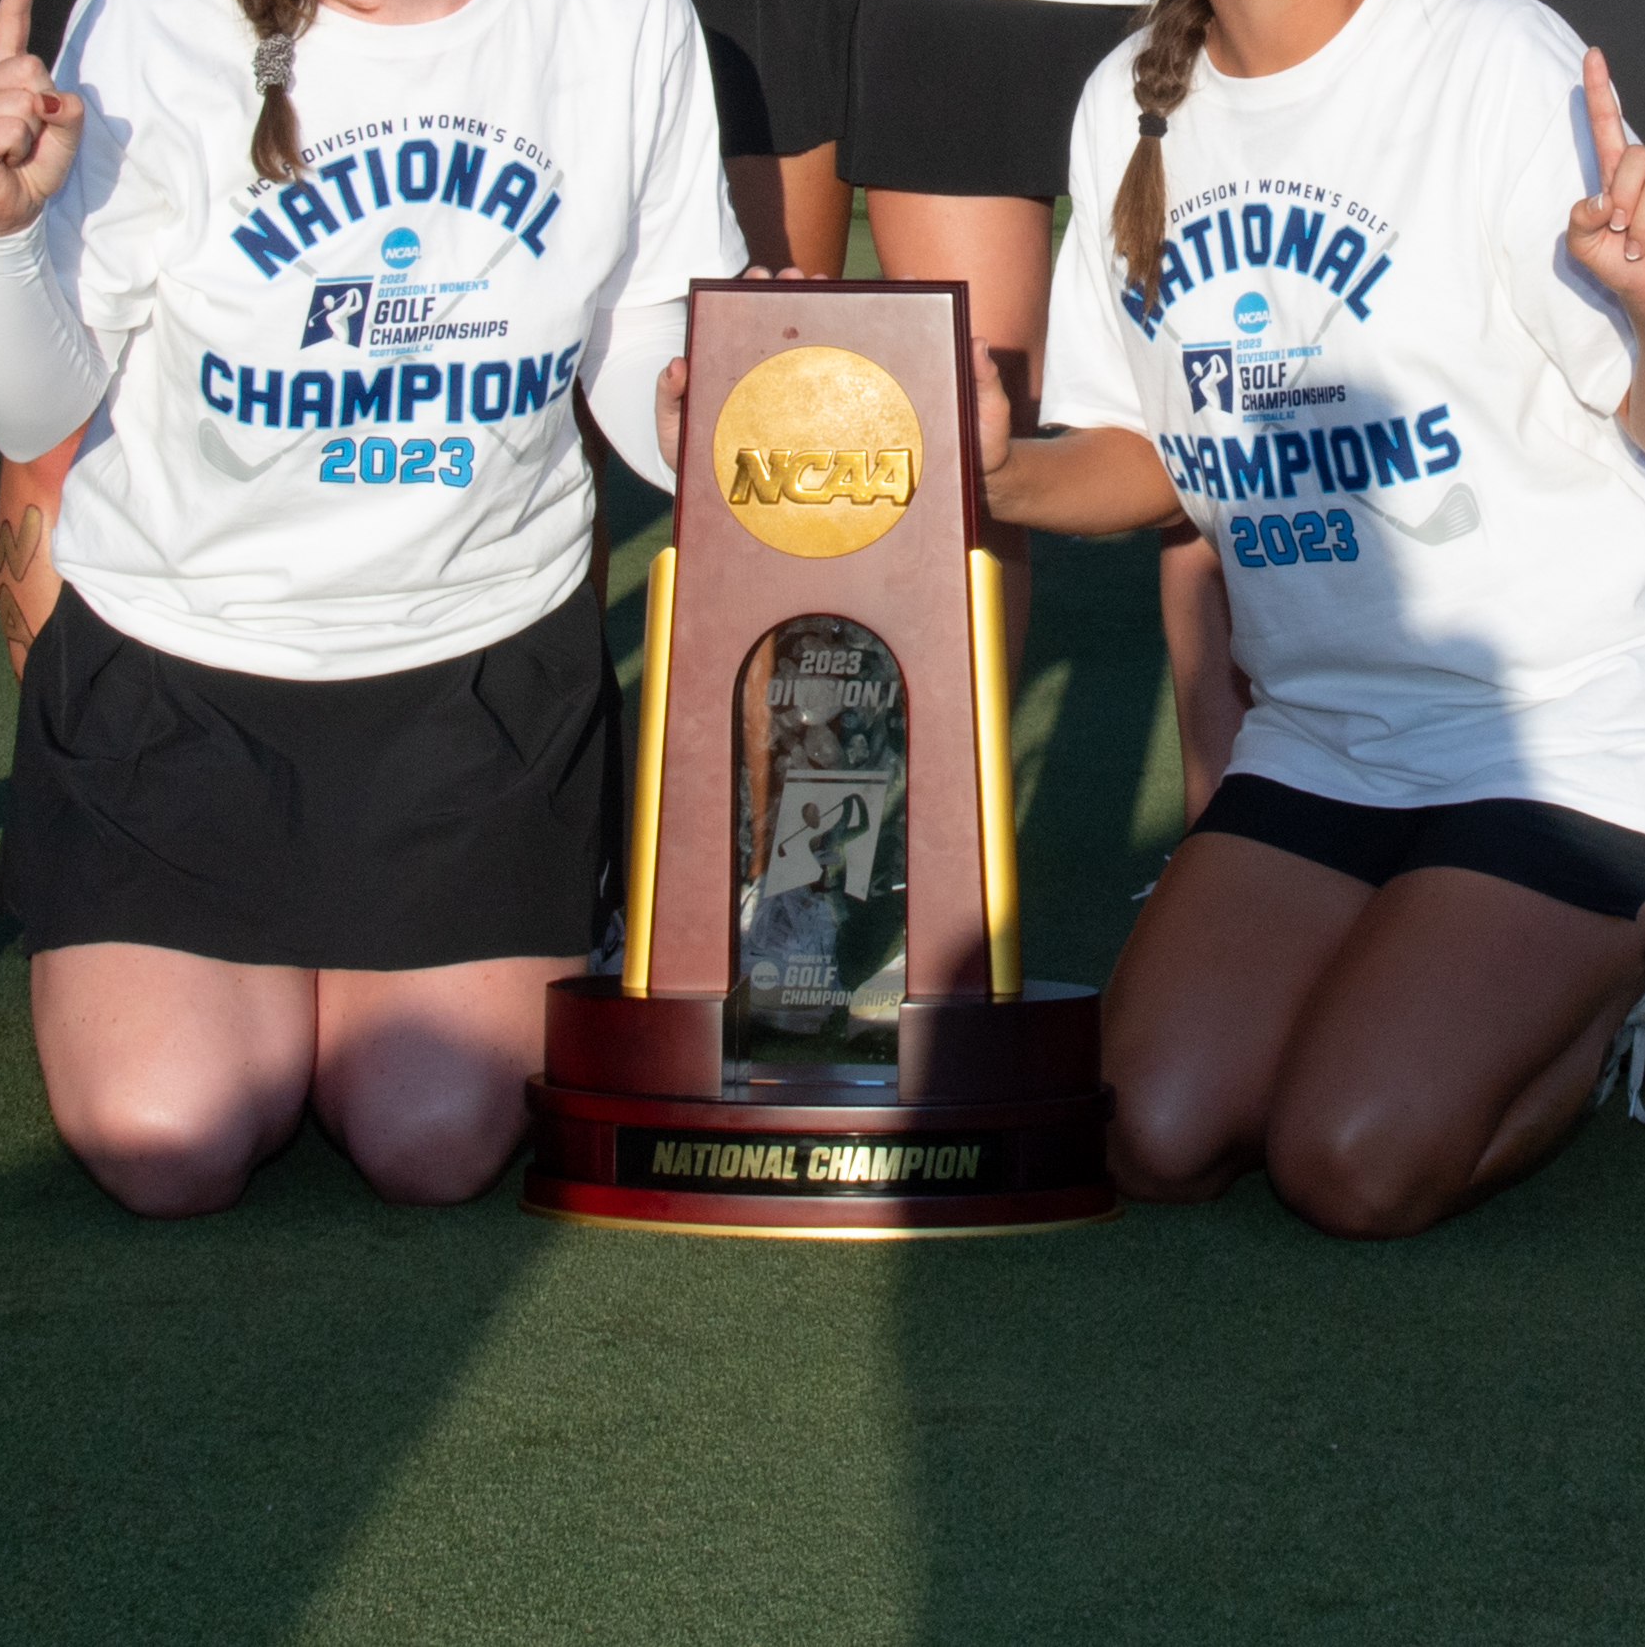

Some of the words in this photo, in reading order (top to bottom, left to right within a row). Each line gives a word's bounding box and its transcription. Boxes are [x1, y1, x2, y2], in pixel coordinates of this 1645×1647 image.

[246, 161, 292, 198] NCA
[302, 120, 394, 164] DIVISION
[419, 114, 507, 144] WOMEN'S
[514, 137, 553, 172] GOLF
[230, 138, 562, 281] NATIONAL
[1170, 182, 1237, 223] DIVISION
[1259, 179, 1343, 208] WOMEN'S
[1346, 201, 1389, 235] GOLF
[384, 246, 419, 260] NCAA
[377, 285, 427, 298] DIVISION
[439, 280, 489, 293] WOMEN'S
[379, 273, 408, 284] 2023
[373, 297, 436, 324] GOLF
[1238, 311, 1270, 324] NCAA
[370, 320, 508, 345] CHAMPIONSHIPS
[1236, 338, 1262, 350] 2023
[200, 339, 583, 429] CHAMPIONS
[1240, 362, 1287, 390] GOLF
[1242, 385, 1346, 411] CHAMPIONSHIPS
[320, 437, 475, 488] 2023
[1159, 403, 1461, 501] CHAMPIONS
[729, 448, 915, 506] NCAA
[1230, 508, 1359, 568] 2023
[799, 649, 863, 675] 2023
[887, 680, 897, 708] I
[783, 966, 838, 988] GOLF
[652, 1141, 798, 1180] NATIONAL
[806, 1145, 981, 1183] CHAMPION
